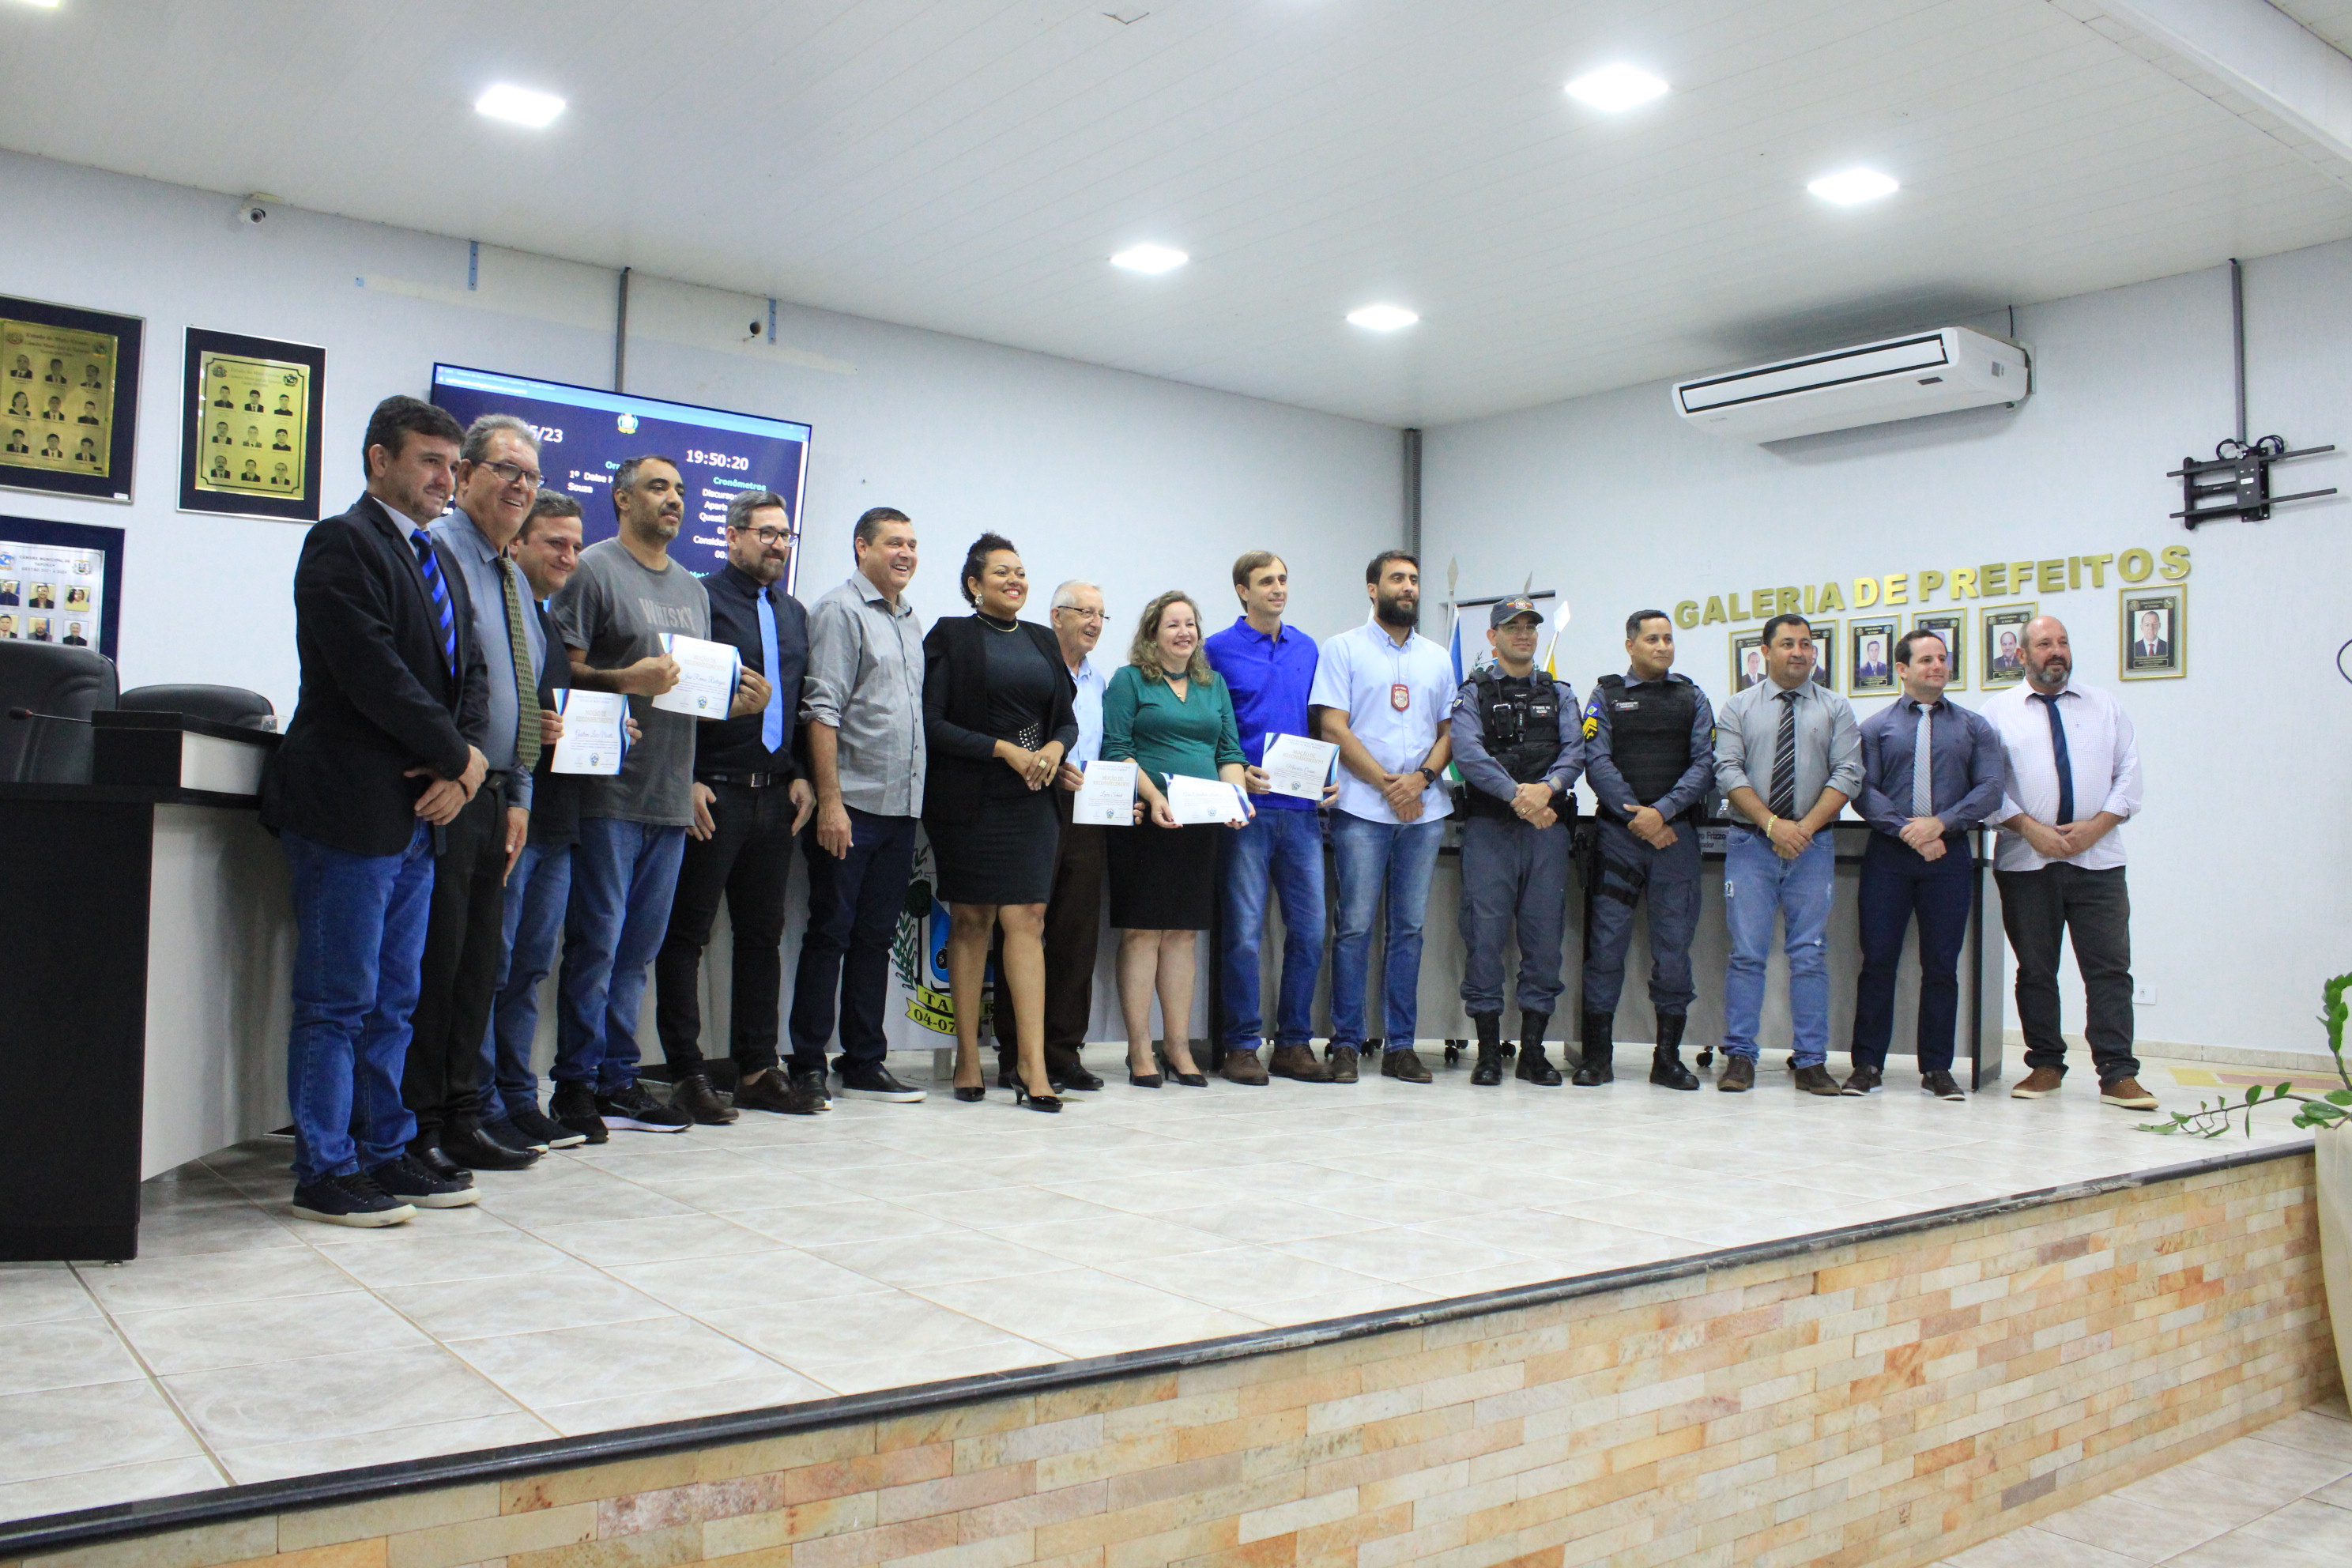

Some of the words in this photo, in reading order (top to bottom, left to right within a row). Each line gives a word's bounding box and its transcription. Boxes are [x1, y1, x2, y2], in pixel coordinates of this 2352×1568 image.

[527, 424, 564, 443] 5/23
[685, 449, 749, 471] 19:50:20
[568, 470, 580, 479] 1º
[583, 472, 607, 484] Daise
[712, 477, 767, 491] Cronômetros
[567, 481, 594, 493] Souza
[699, 512, 726, 523] Questã
[693, 535, 728, 547] Consider
[714, 549, 728, 560] 00:
[1674, 582, 1845, 629] GALERIA
[1853, 573, 1908, 609] DE
[1918, 545, 2192, 601] PREFEITOS
[1706, 831, 1727, 840] Frizzo
[924, 991, 950, 1012] TA
[914, 1008, 956, 1033] 04-07
